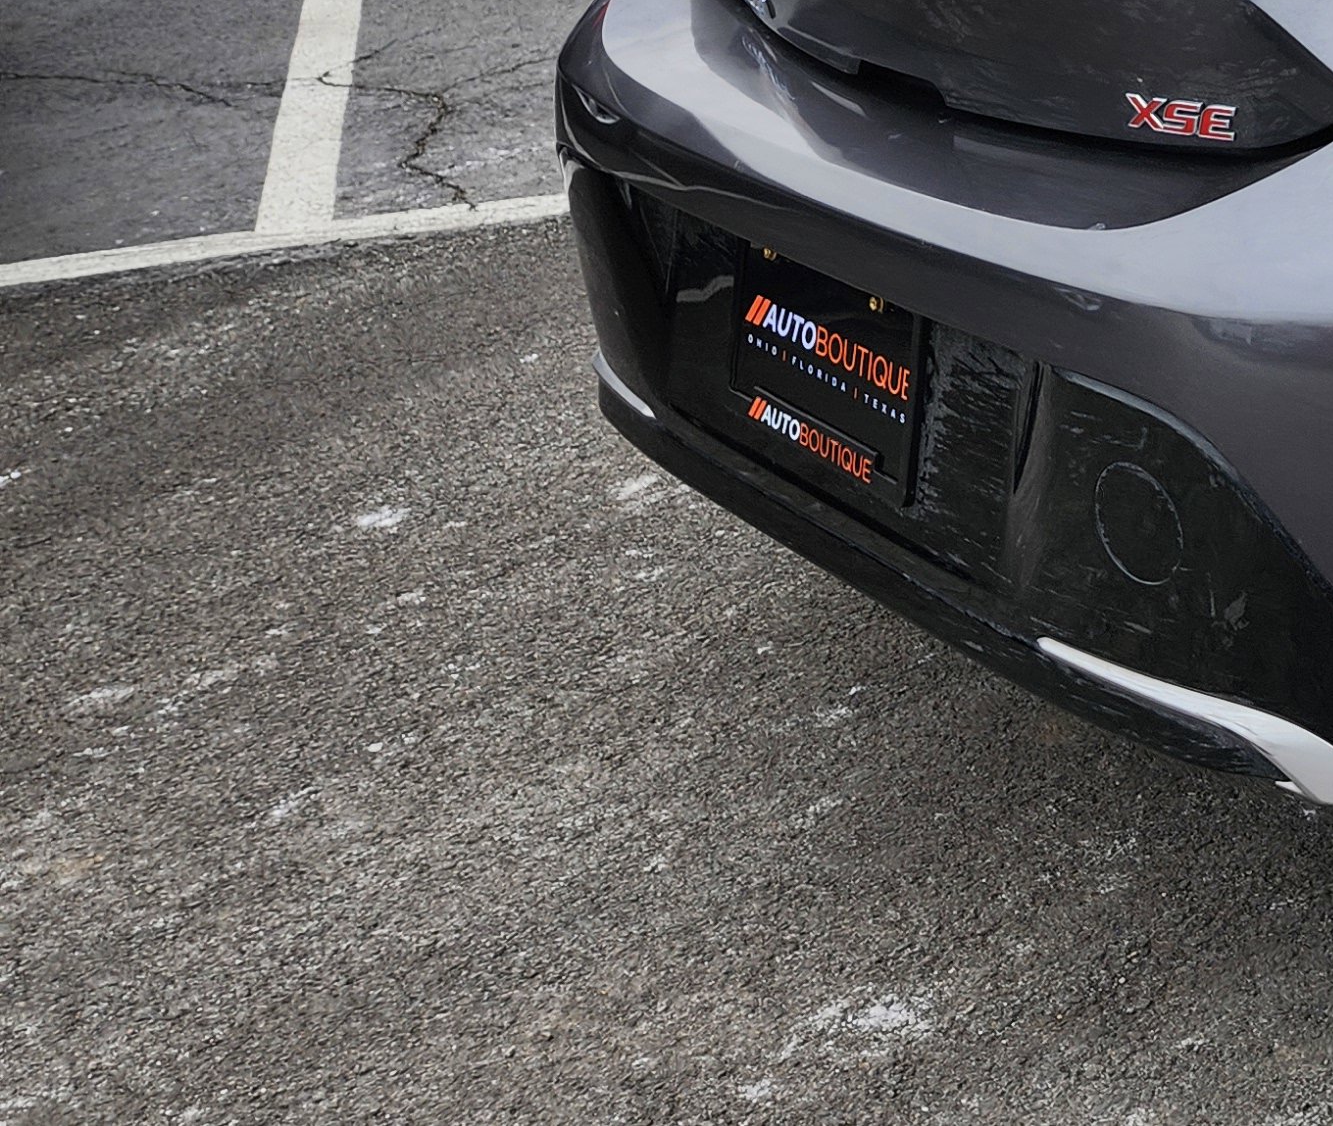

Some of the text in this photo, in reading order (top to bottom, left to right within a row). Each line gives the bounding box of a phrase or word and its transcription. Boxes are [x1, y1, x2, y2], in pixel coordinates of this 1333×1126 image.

[1125, 92, 1236, 141] XSE
[747, 333, 906, 424] OHIO FLORIDA TEXAS
[763, 303, 910, 401] AUTOBOUTIQUE
[760, 404, 872, 484] AUTOBOUTIQUE
